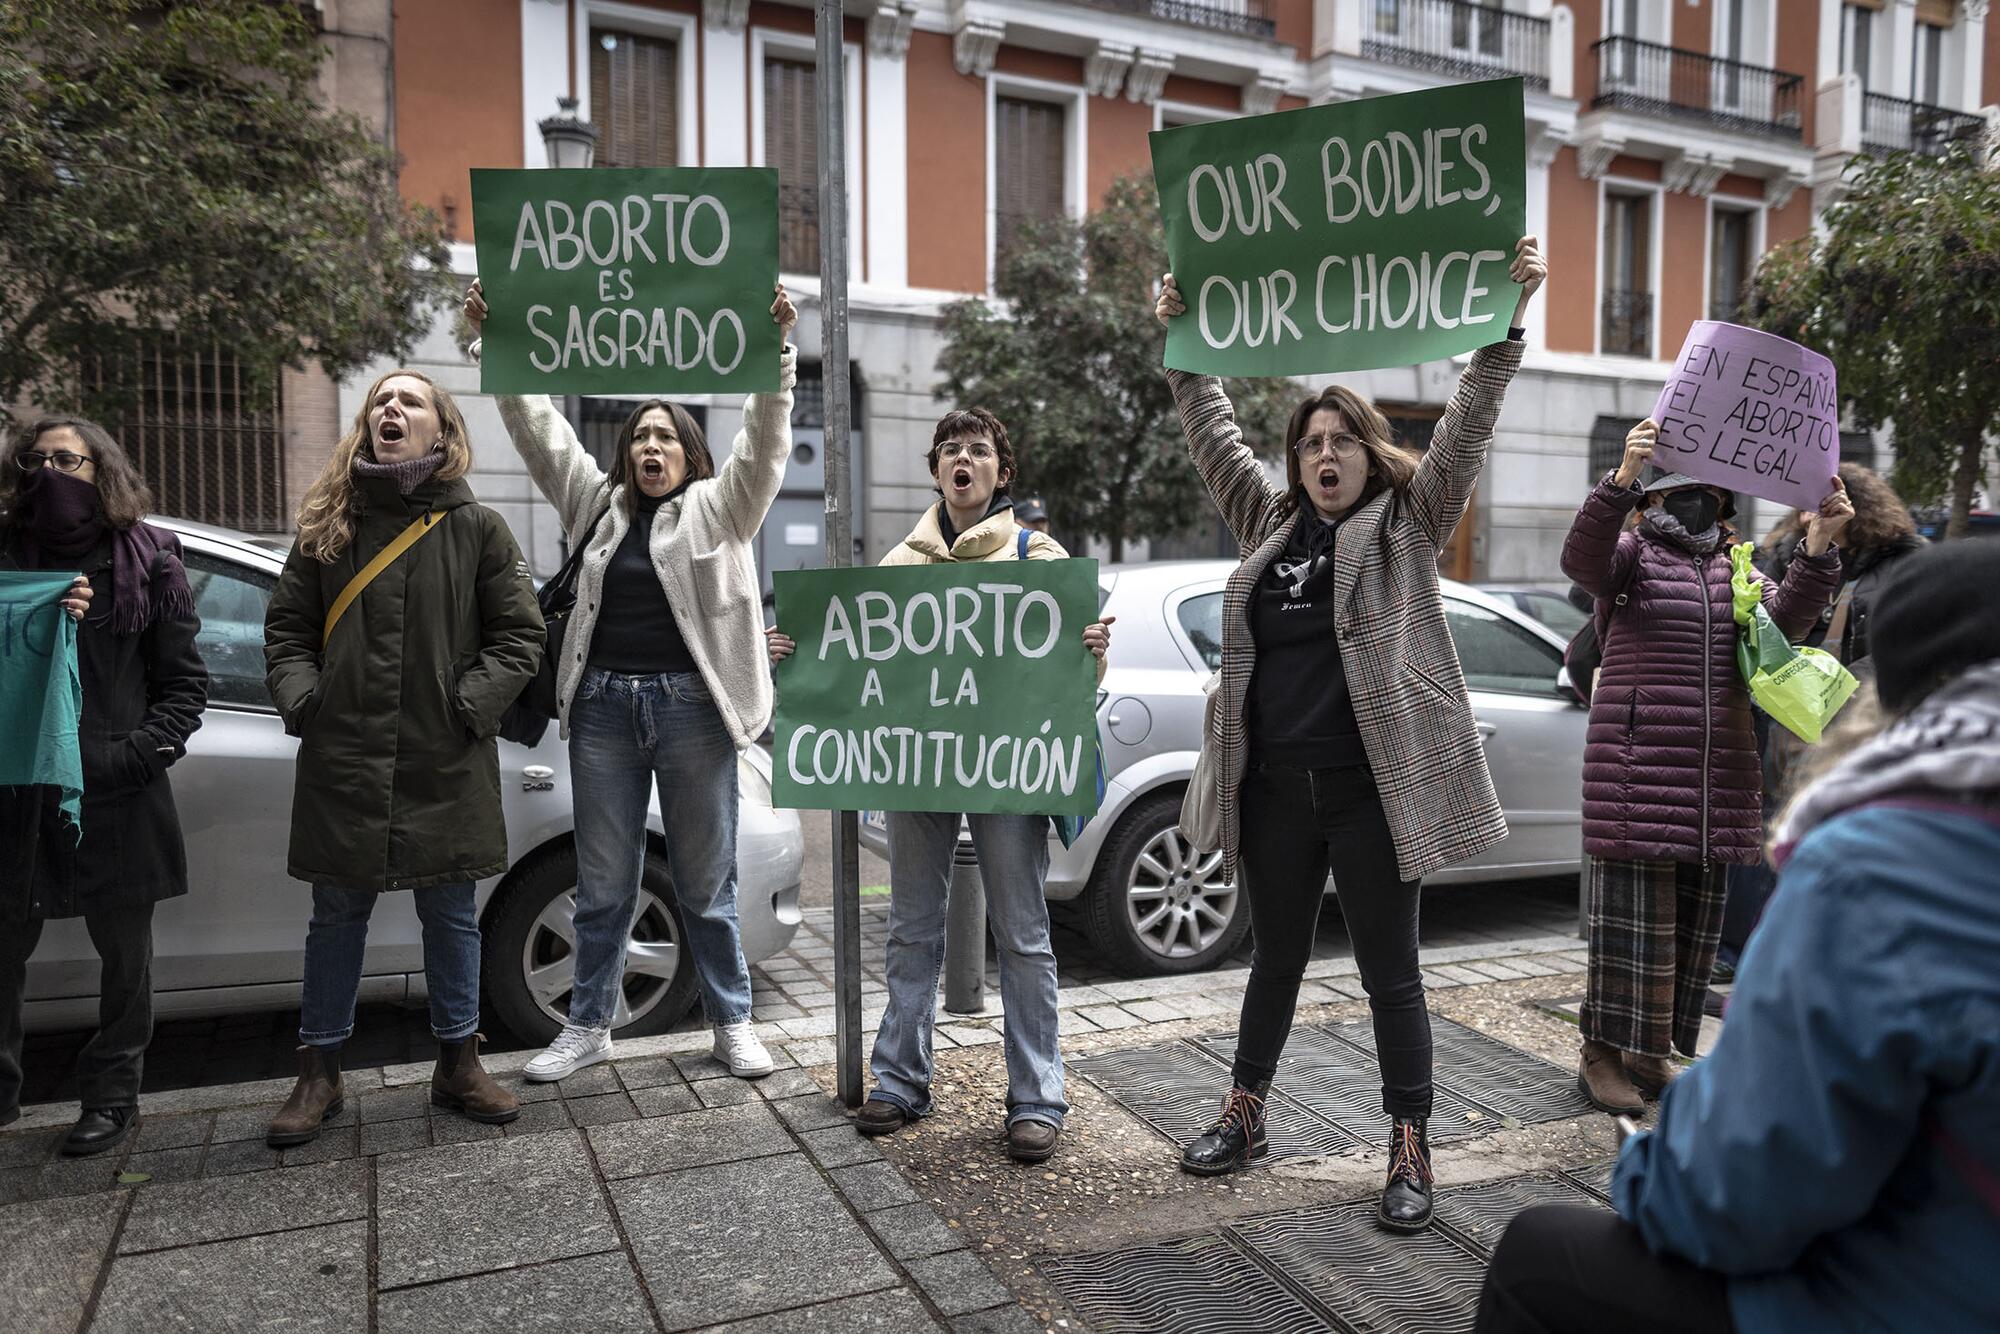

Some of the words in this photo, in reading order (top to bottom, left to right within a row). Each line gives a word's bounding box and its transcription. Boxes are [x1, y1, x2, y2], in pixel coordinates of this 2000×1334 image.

[1187, 153, 1302, 243] OUR
[1320, 123, 1501, 224] BODIES,
[509, 194, 731, 272] ABORTO
[598, 268, 635, 302] ES
[1199, 269, 1302, 350] OUR
[1315, 249, 1506, 334] CHOICE
[526, 304, 746, 376] SAGRADO
[1682, 344, 1731, 381] EN
[1655, 416, 1706, 454] ES
[1708, 430, 1801, 485] LEGAL
[1668, 379, 1707, 419] EL
[1723, 396, 1833, 452] ABORTO
[818, 583, 1062, 661] ABORTO
[860, 667, 884, 707] A
[929, 667, 979, 708] LA
[787, 719, 1082, 796] CONSTITUCIÓN
